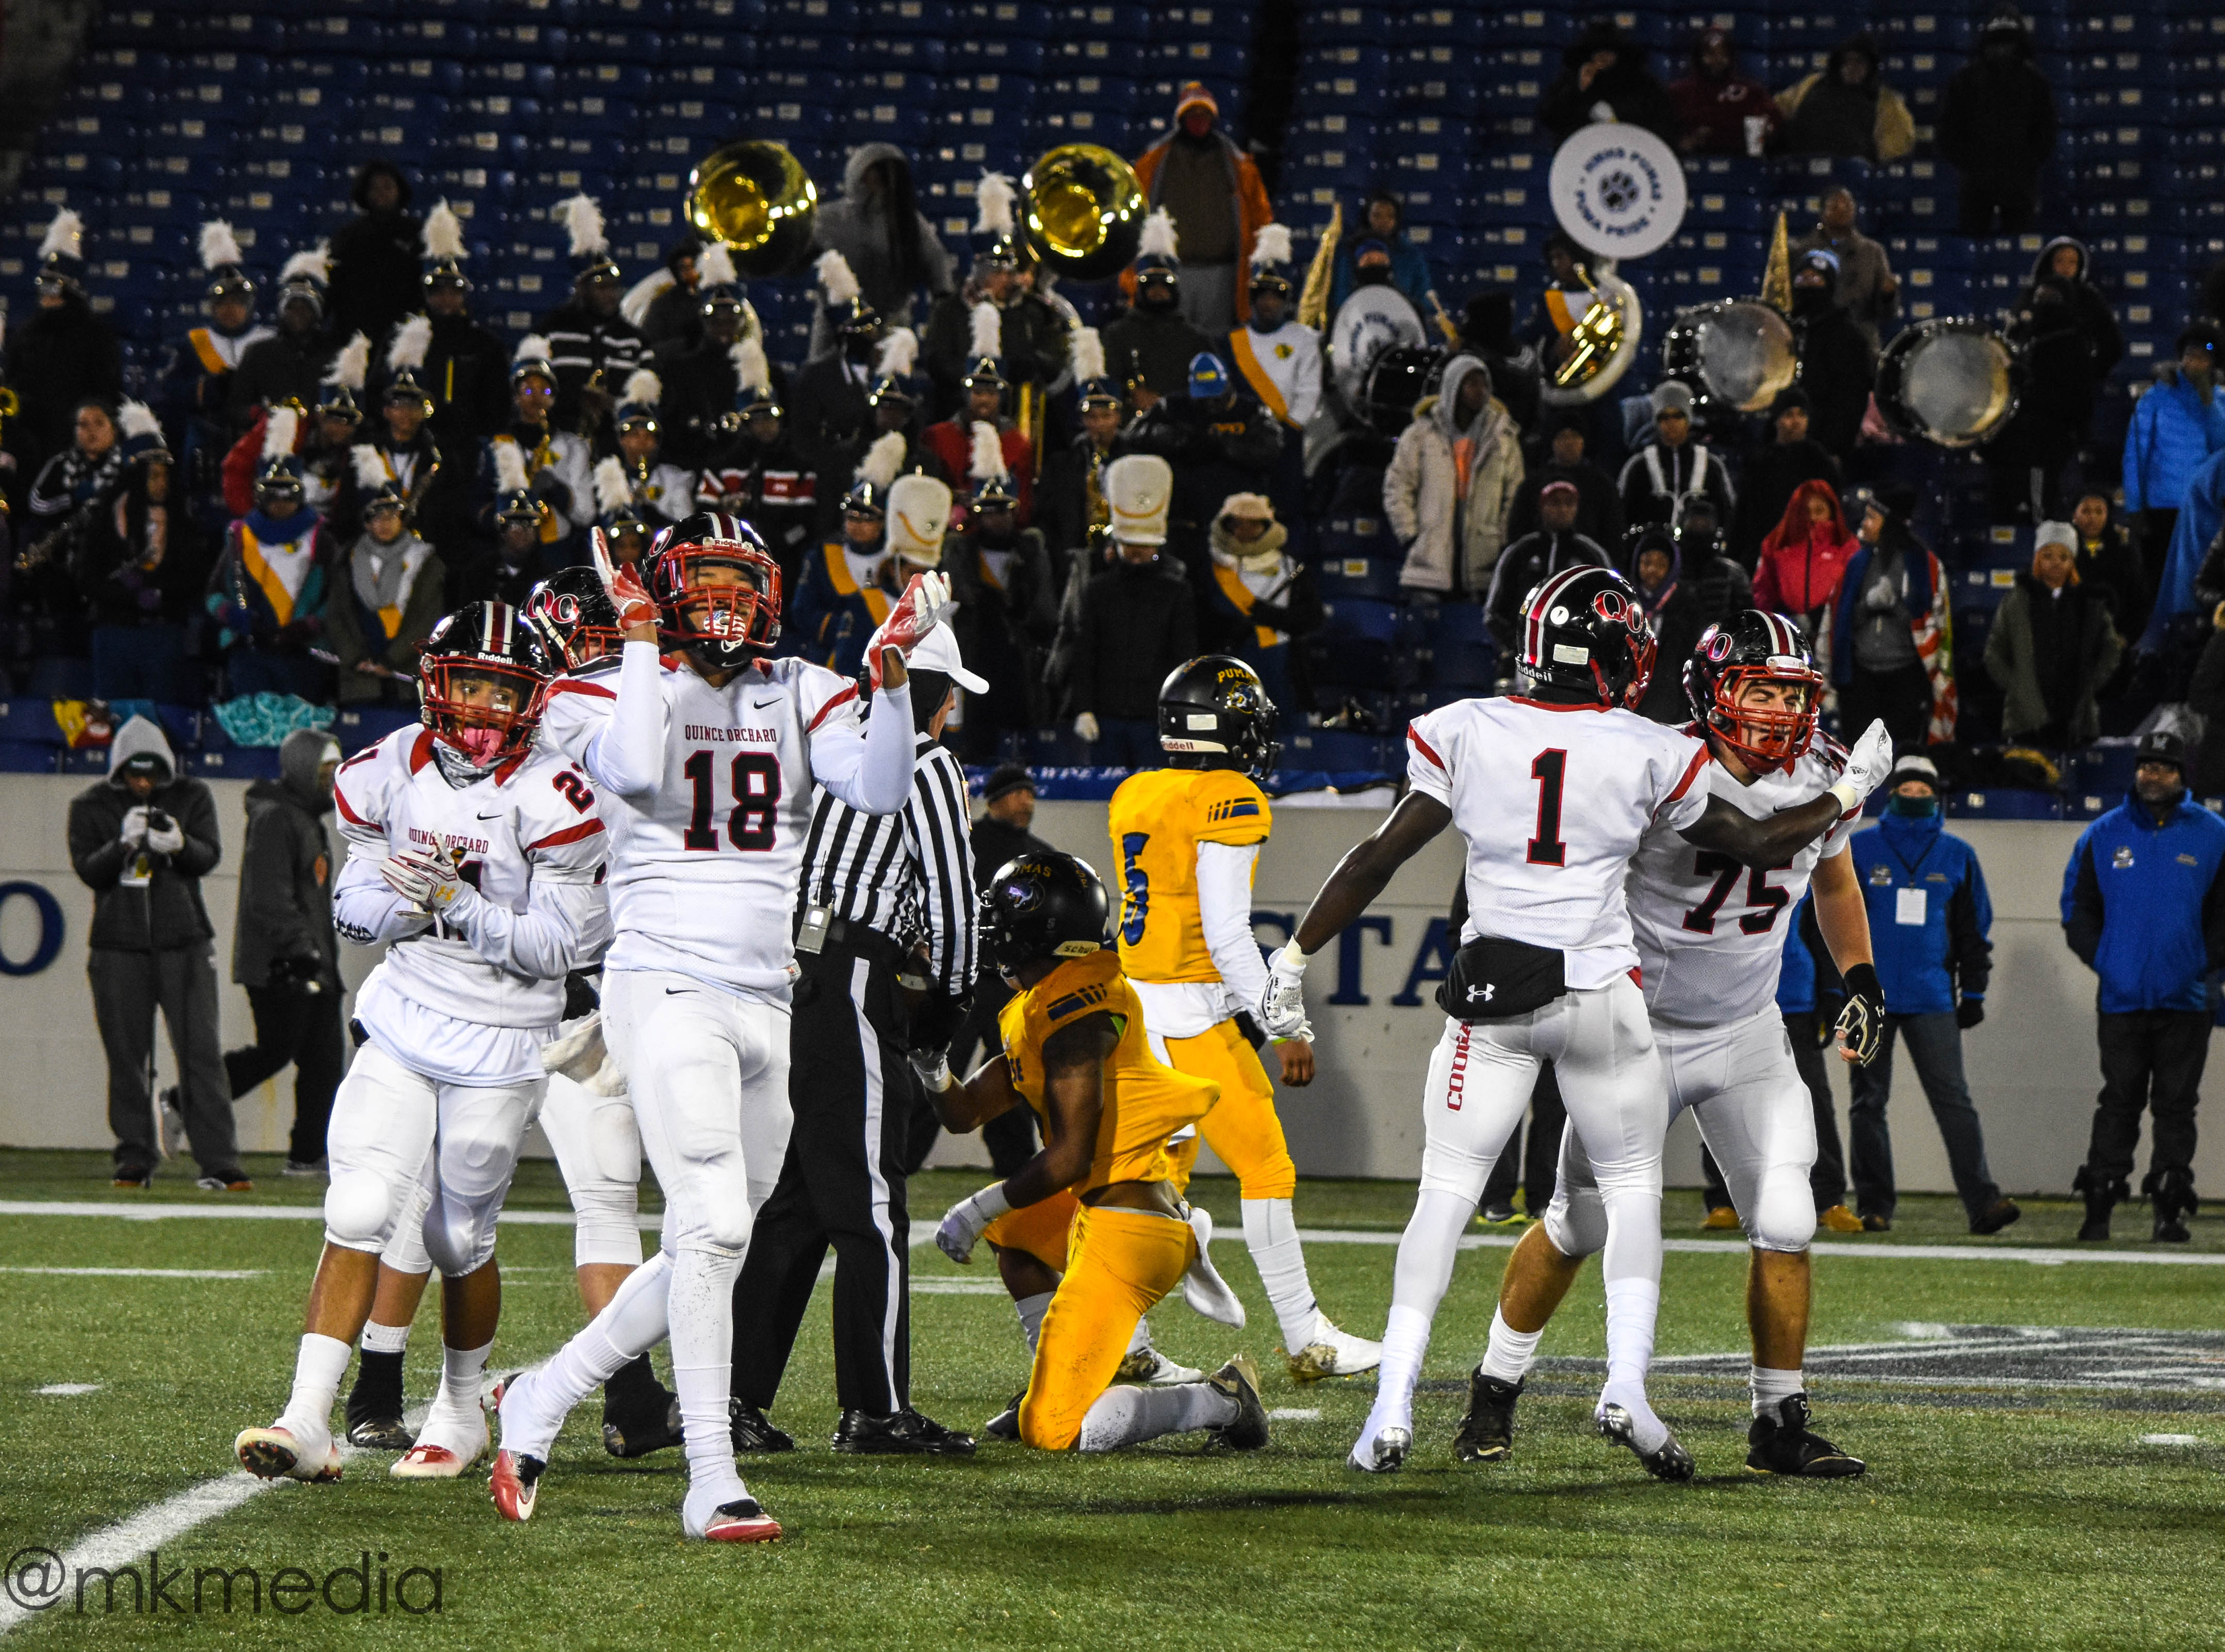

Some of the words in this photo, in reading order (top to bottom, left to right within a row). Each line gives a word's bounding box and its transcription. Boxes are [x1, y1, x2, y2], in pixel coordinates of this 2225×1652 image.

[714, 539, 743, 548] Riddell
[1594, 590, 1644, 634] QO
[477, 651, 513, 665] Riddell
[1516, 661, 1553, 682] Riddell
[684, 724, 725, 742] QUINCE
[726, 728, 777, 742] ORCHARD
[552, 762, 595, 815] 2
[684, 749, 782, 852] 18
[1526, 747, 1567, 868] 1
[408, 827, 436, 846] QUINC
[1122, 831, 1151, 947] 5
[1682, 850, 1795, 936] 75
